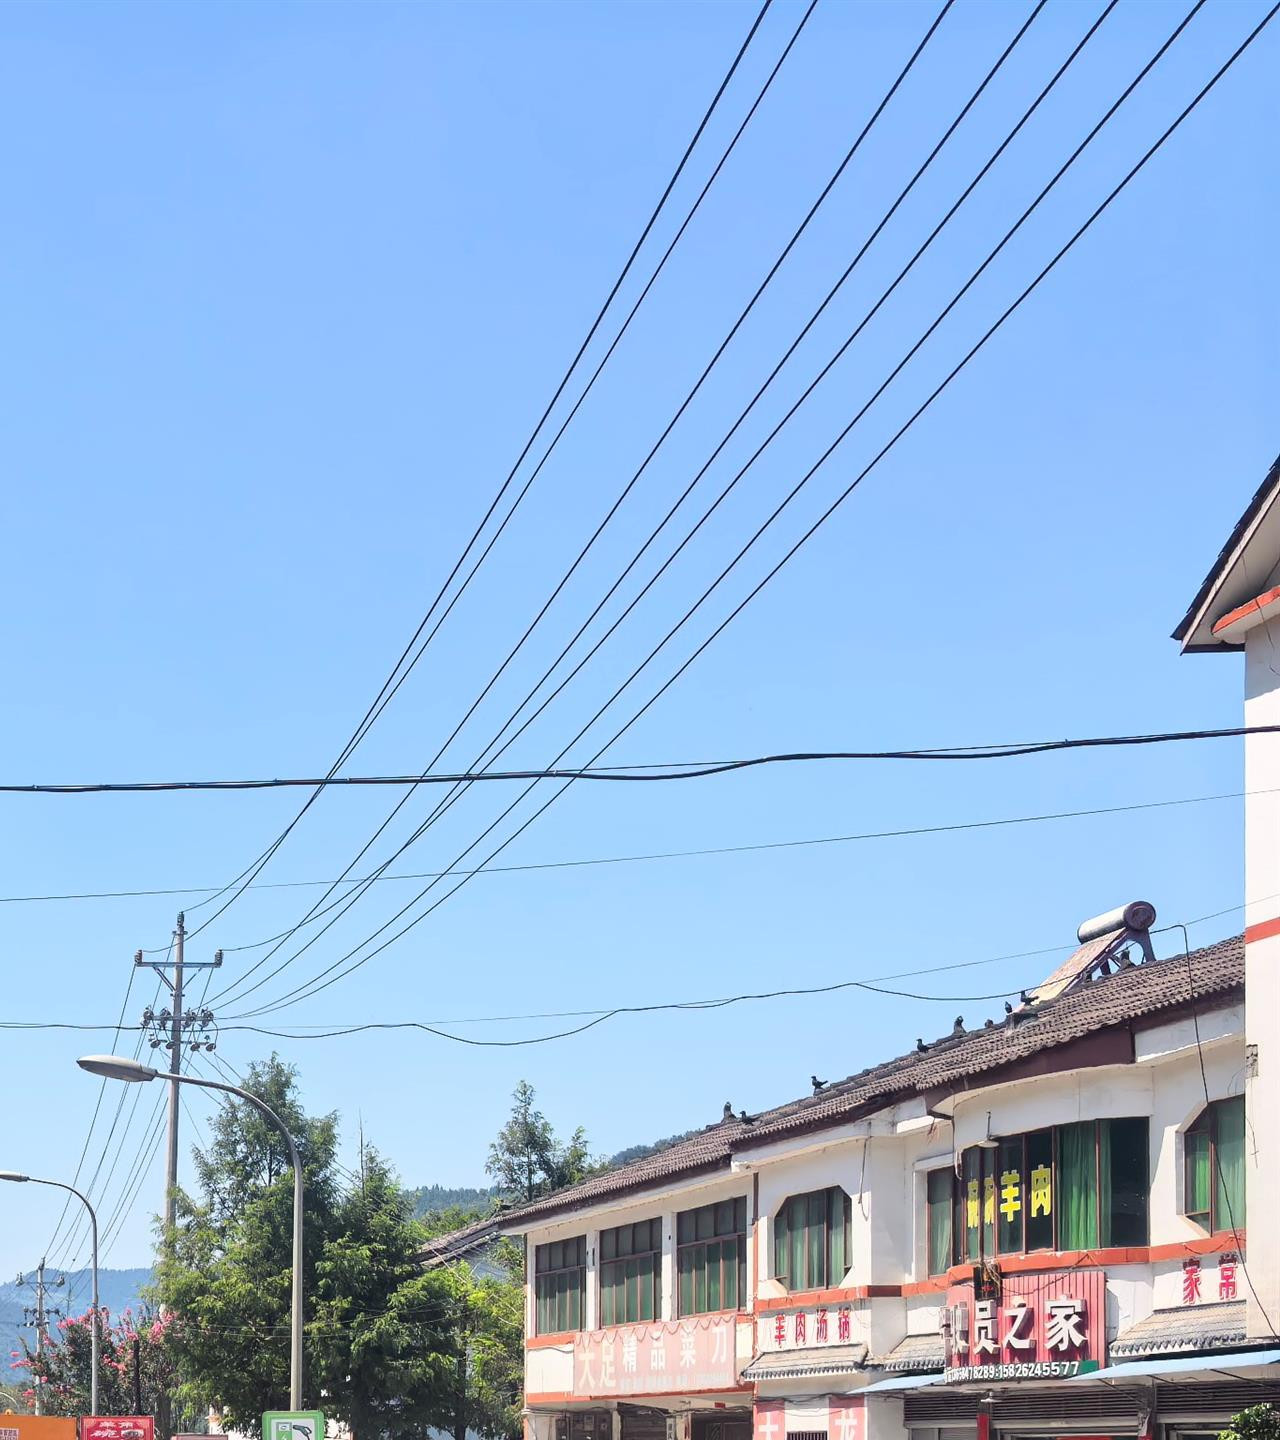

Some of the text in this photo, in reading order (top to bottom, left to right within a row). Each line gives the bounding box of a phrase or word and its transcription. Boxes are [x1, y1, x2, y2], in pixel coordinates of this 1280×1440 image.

[1183, 1252, 1239, 1304] 家常
[774, 1306, 851, 1348] 羊肉汤锅
